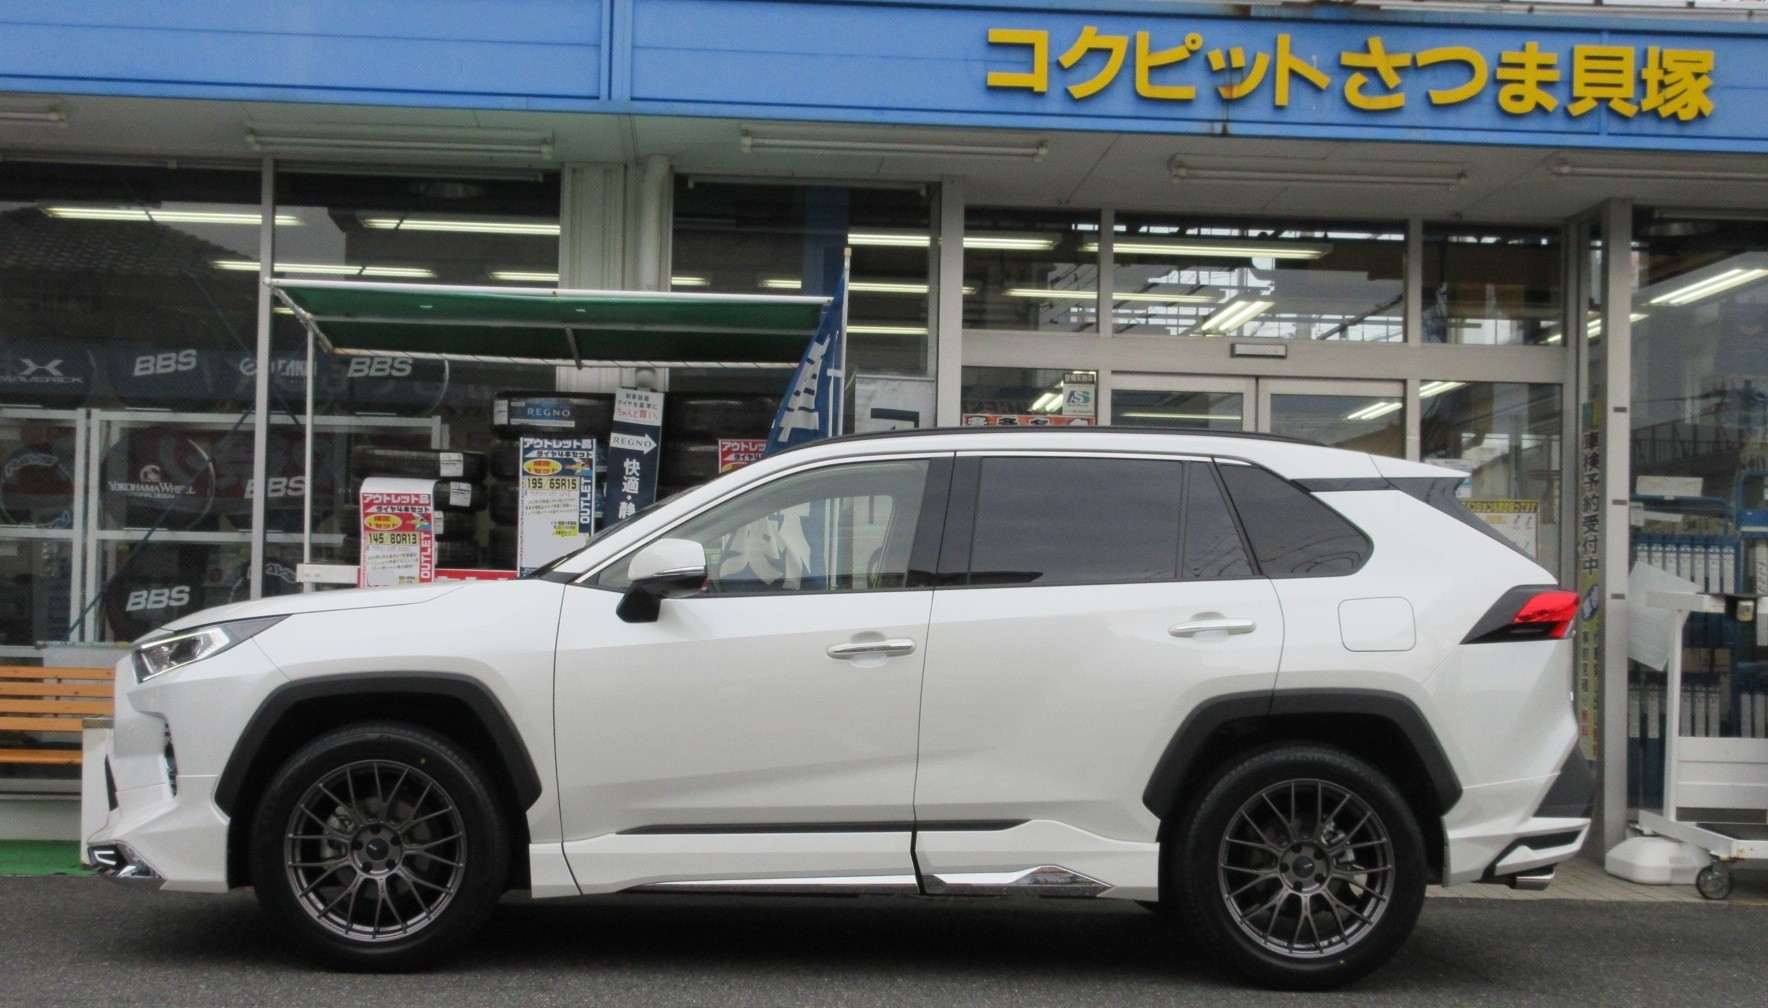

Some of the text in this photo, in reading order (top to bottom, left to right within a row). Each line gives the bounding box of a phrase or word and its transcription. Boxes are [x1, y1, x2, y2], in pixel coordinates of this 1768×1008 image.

[987, 26, 1715, 121] コクピットさつま貝塚
[133, 349, 197, 377] BBS
[347, 356, 413, 377] BBS
[527, 407, 571, 417] REGNO
[523, 439, 592, 449] アウトレット品
[613, 437, 652, 448] REGNO
[363, 493, 431, 505] アウトレット品
[580, 477, 592, 525] OUTLET
[1582, 431, 1600, 575] 車検予約受付中
[420, 532, 432, 580] OUTLET
[126, 585, 191, 612] BBS
